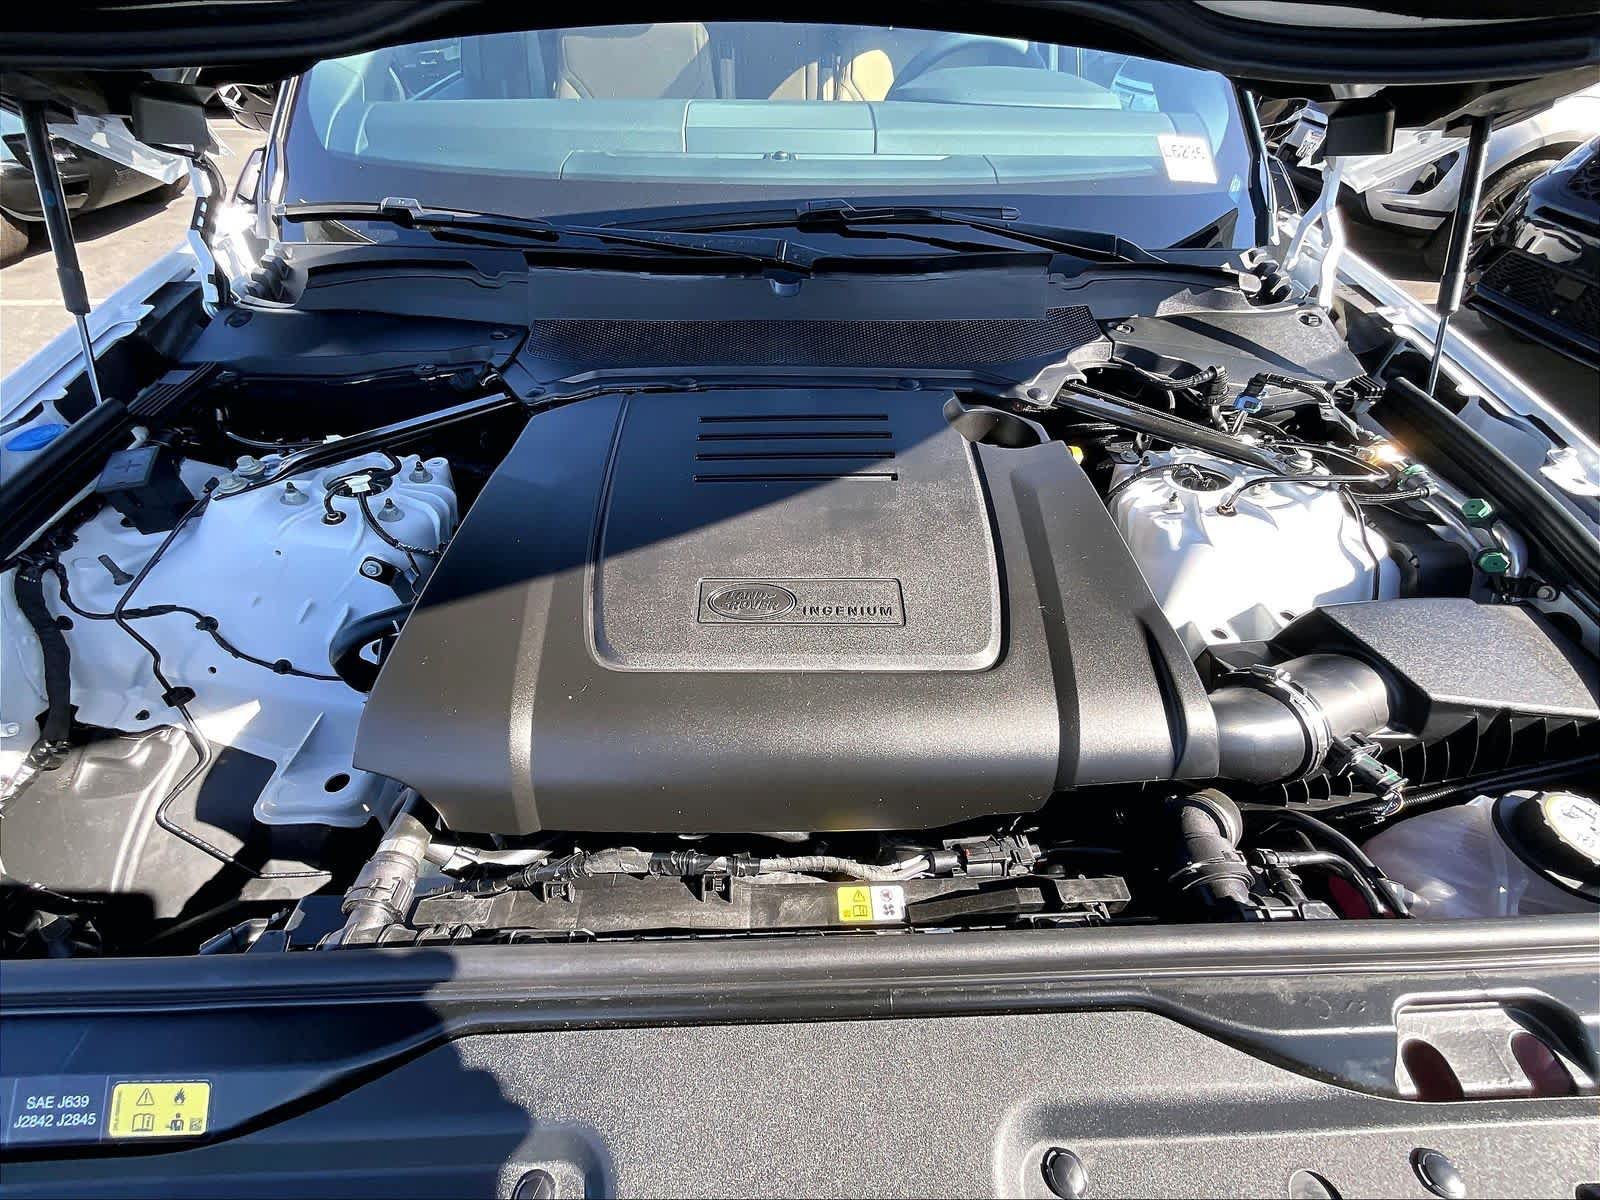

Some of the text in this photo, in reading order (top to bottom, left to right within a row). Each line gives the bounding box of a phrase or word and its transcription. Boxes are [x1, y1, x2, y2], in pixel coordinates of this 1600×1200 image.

[729, 600, 780, 611] ROVER
[802, 605, 893, 617] INGENIUM
[26, 1095, 90, 1110] SAE J639
[13, 1112, 97, 1129] J2842 J2845
